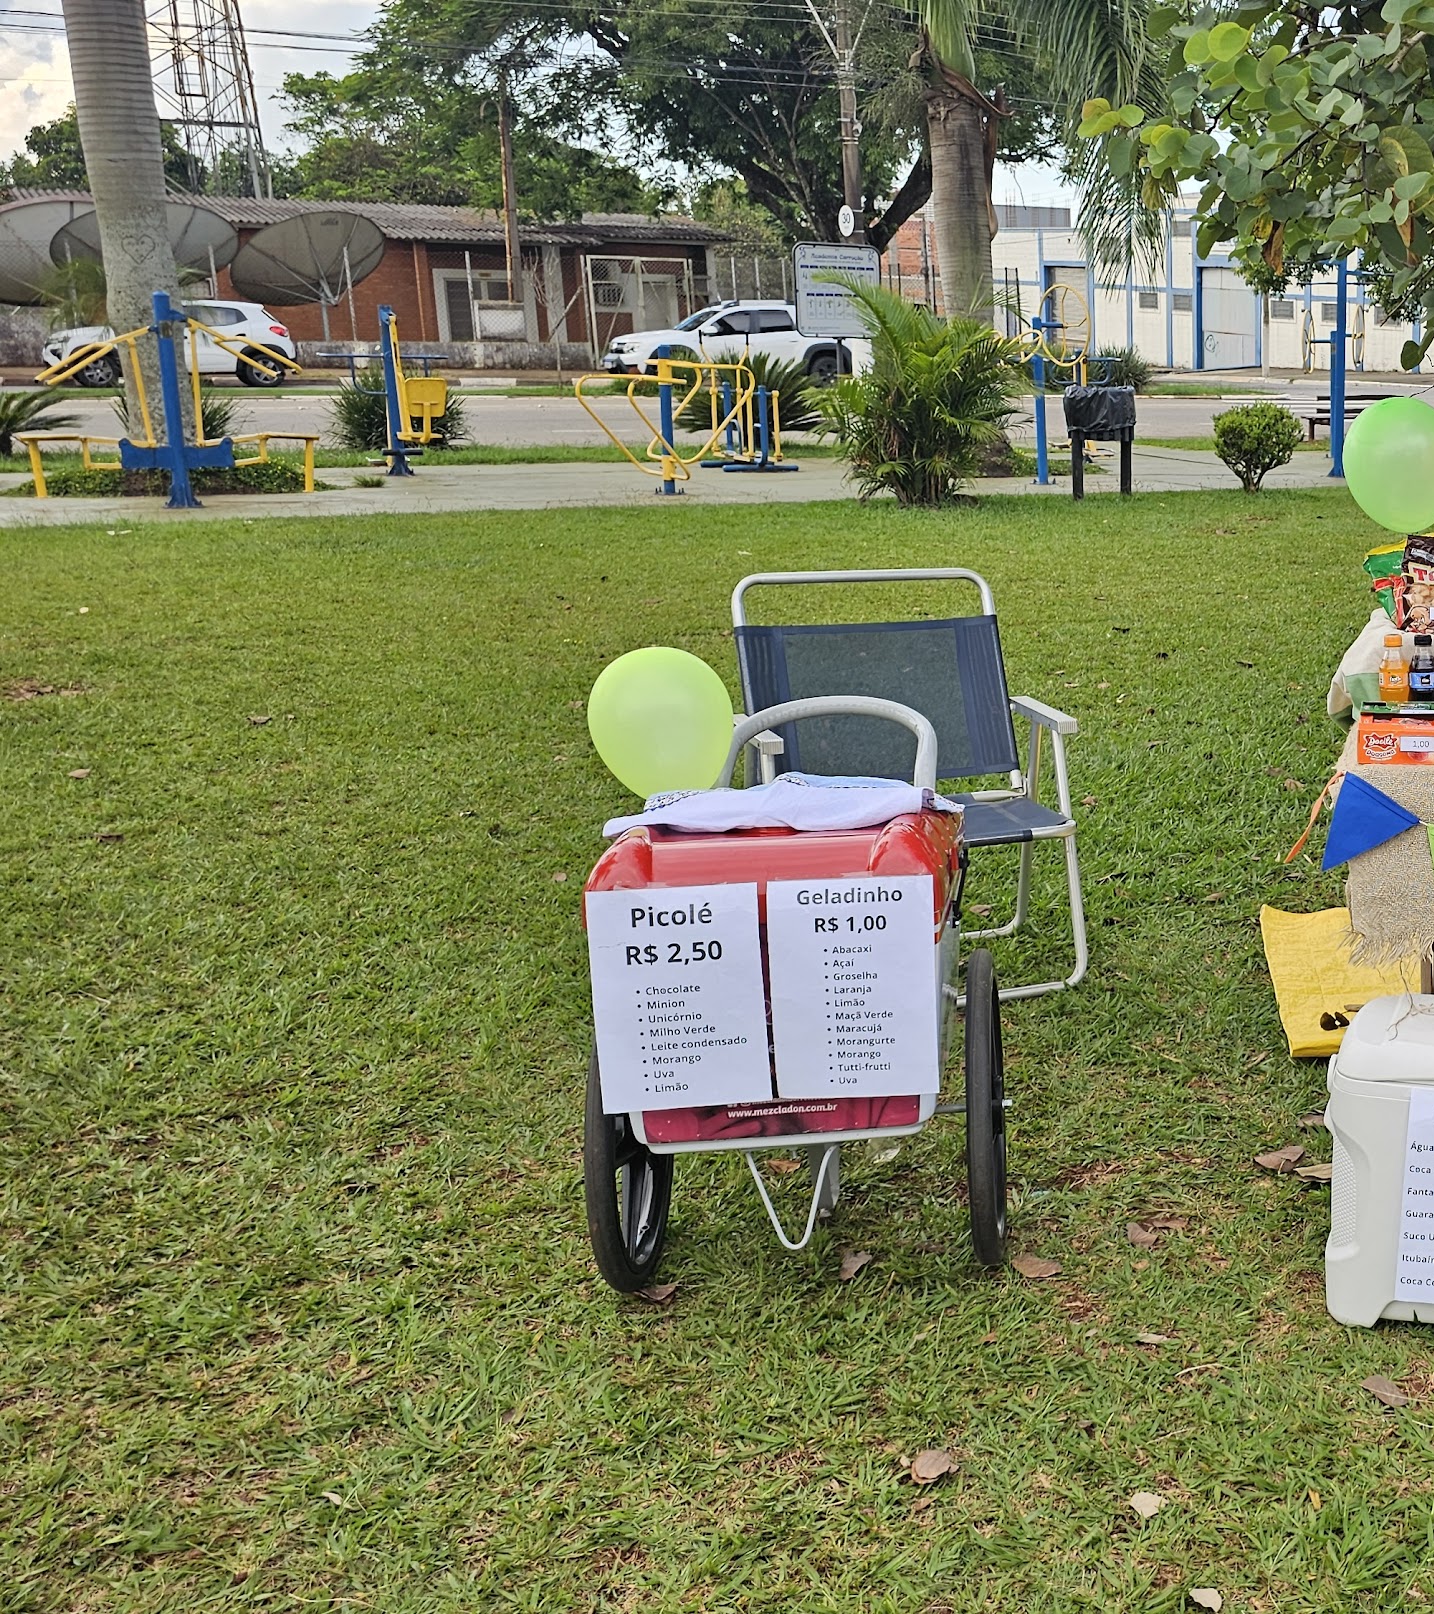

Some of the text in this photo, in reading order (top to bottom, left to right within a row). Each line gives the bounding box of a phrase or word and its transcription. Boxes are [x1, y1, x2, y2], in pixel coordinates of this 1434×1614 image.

[842, 213, 850, 224] 30
[796, 886, 903, 905] Geladinho
[631, 902, 712, 928] Picolé
[814, 915, 887, 934] R$ 1,00
[626, 941, 722, 966] R$ 2,50
[832, 945, 872, 954] Abacaxi
[832, 958, 854, 968] Açaí
[833, 971, 878, 981] Groselha
[646, 984, 700, 996] Chocolate
[834, 985, 872, 996] Laranja
[647, 1000, 685, 1010] Minion
[834, 998, 865, 1007] Limão
[648, 1012, 702, 1024] Unicórnio
[835, 1010, 894, 1022] Maçã Verde
[650, 1024, 716, 1038] Milho Verde
[836, 1024, 882, 1034] Maracujá
[651, 1036, 748, 1052] Leite condensado
[836, 1036, 896, 1046] Morangurte
[652, 1054, 702, 1066] Morango
[838, 1050, 881, 1060] Morango
[838, 1062, 890, 1072] Tutti-frutti
[654, 1070, 674, 1079] Uva
[838, 1076, 858, 1084] Uva
[655, 1082, 688, 1093] Limão
[728, 1103, 838, 1118] www.mezcladon.com.br
[1410, 1142, 1434, 1152] Água
[1409, 1166, 1431, 1174] Coca
[1408, 1188, 1434, 1197] Fanta
[1404, 1232, 1426, 1240] Suco
[1400, 1276, 1422, 1286] Coca
